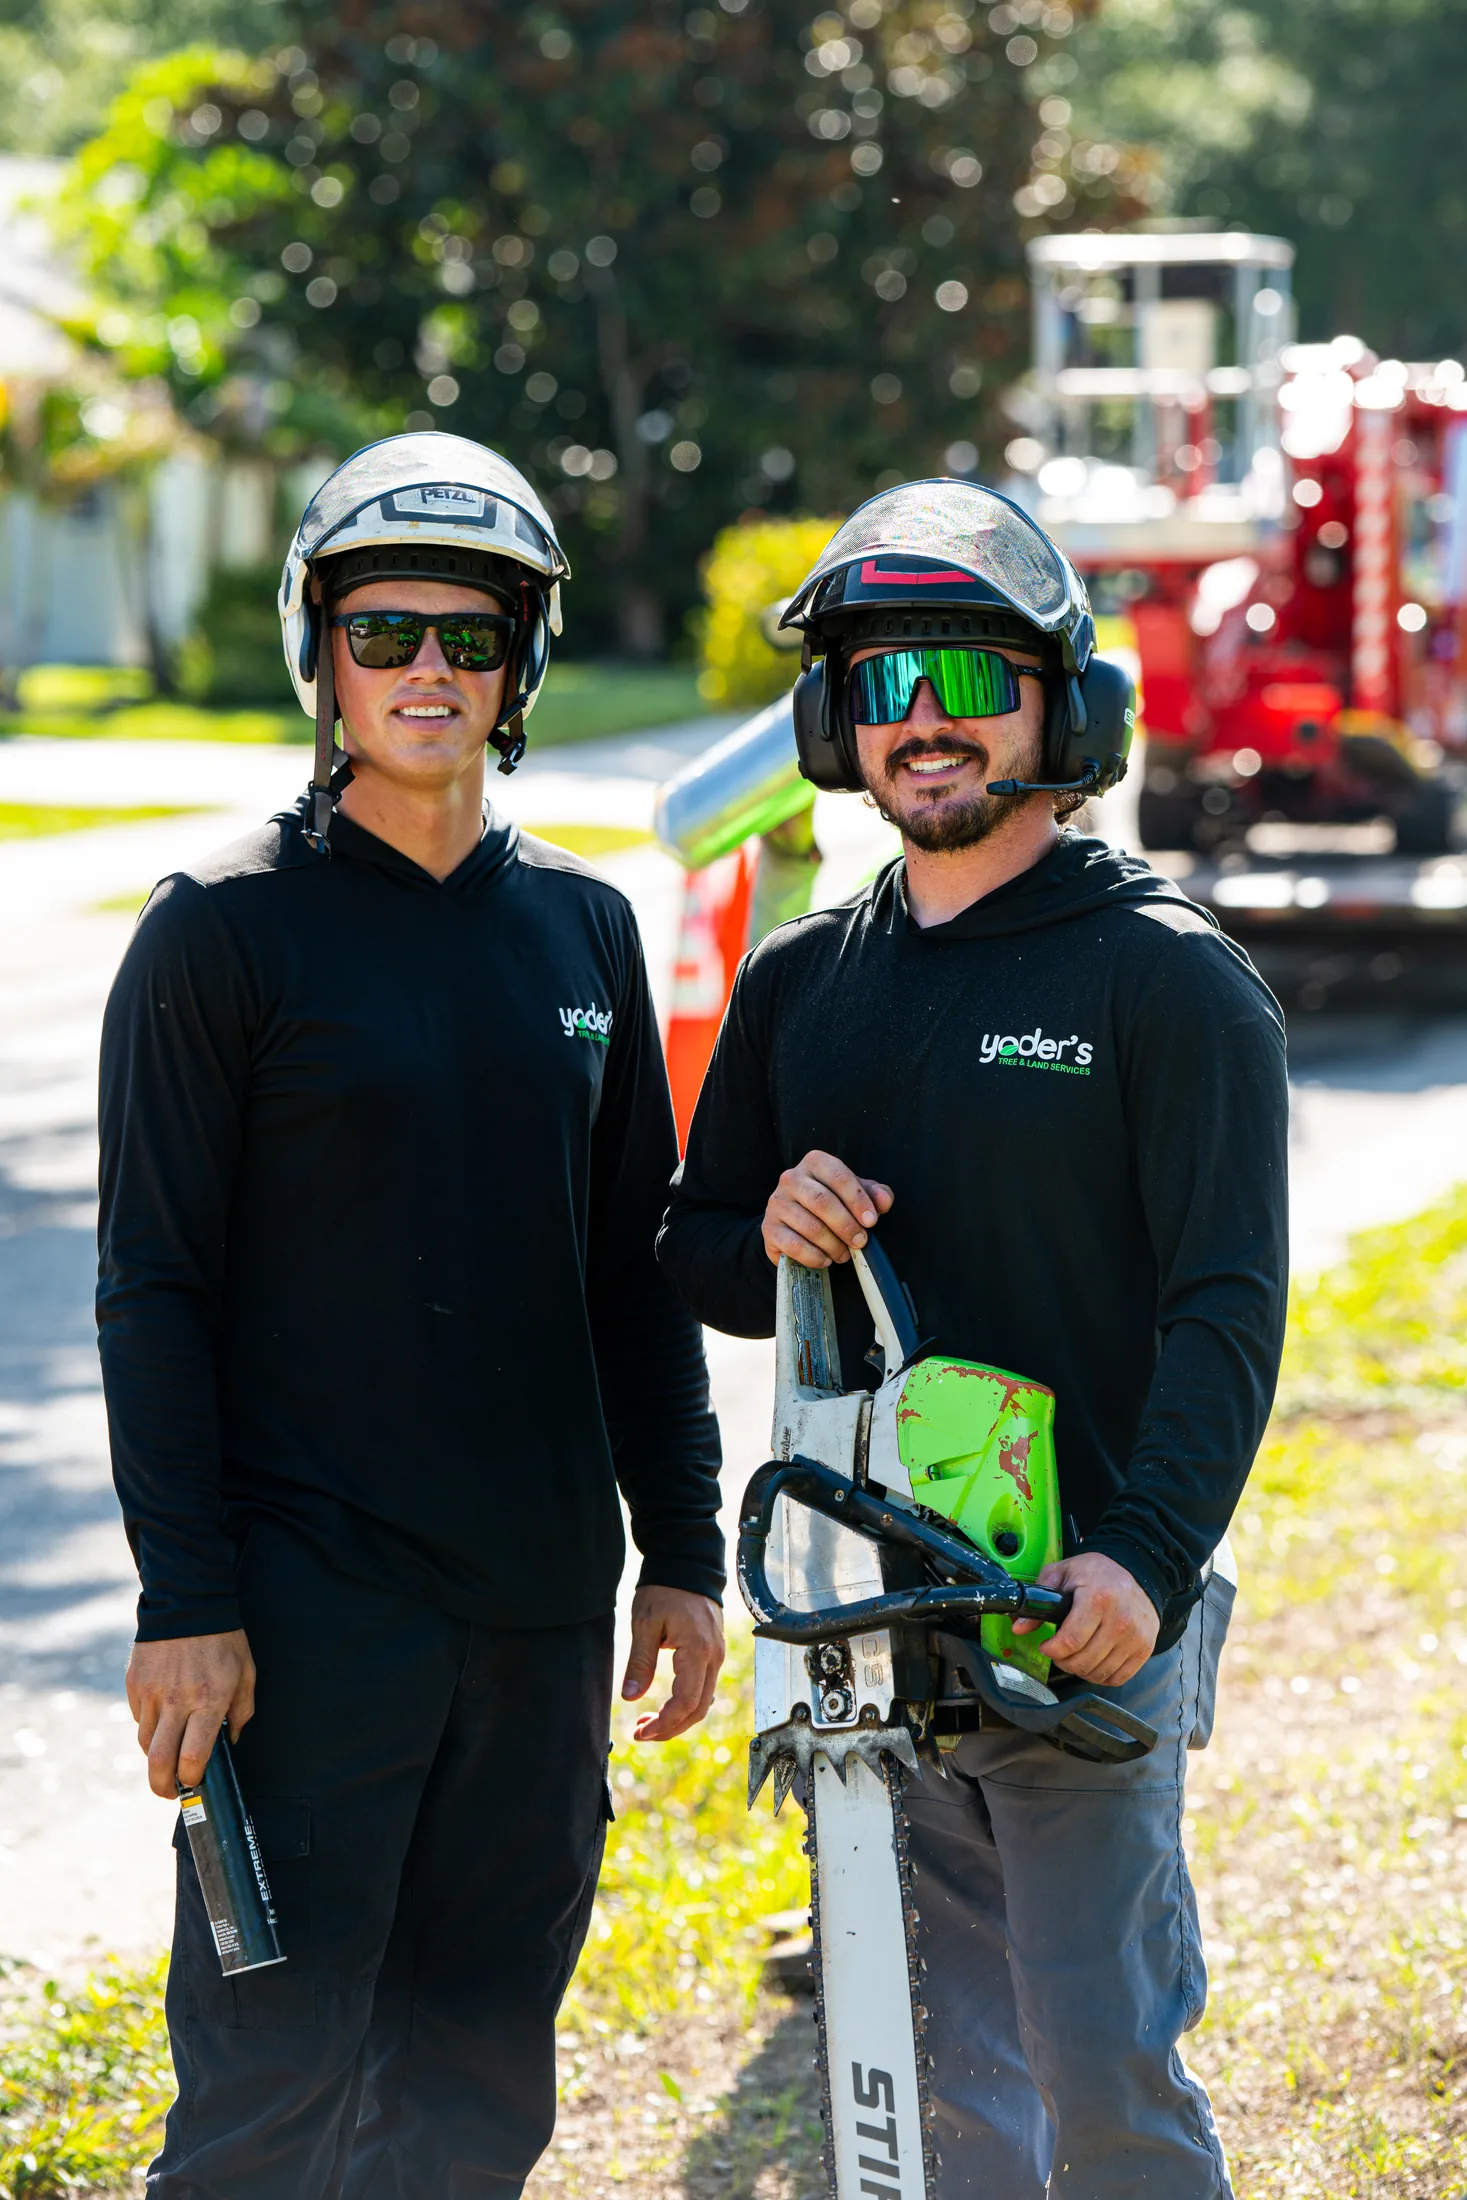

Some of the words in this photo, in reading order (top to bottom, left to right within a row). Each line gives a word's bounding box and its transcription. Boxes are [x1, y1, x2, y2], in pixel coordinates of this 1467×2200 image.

[420, 487, 476, 504] PETZL
[979, 1027, 1094, 1065] yoder's
[998, 1057, 1018, 1066] TREE
[1019, 1058, 1025, 1067] &
[1027, 1059, 1049, 1070] LAND
[1050, 1063, 1091, 1076] SERVICES
